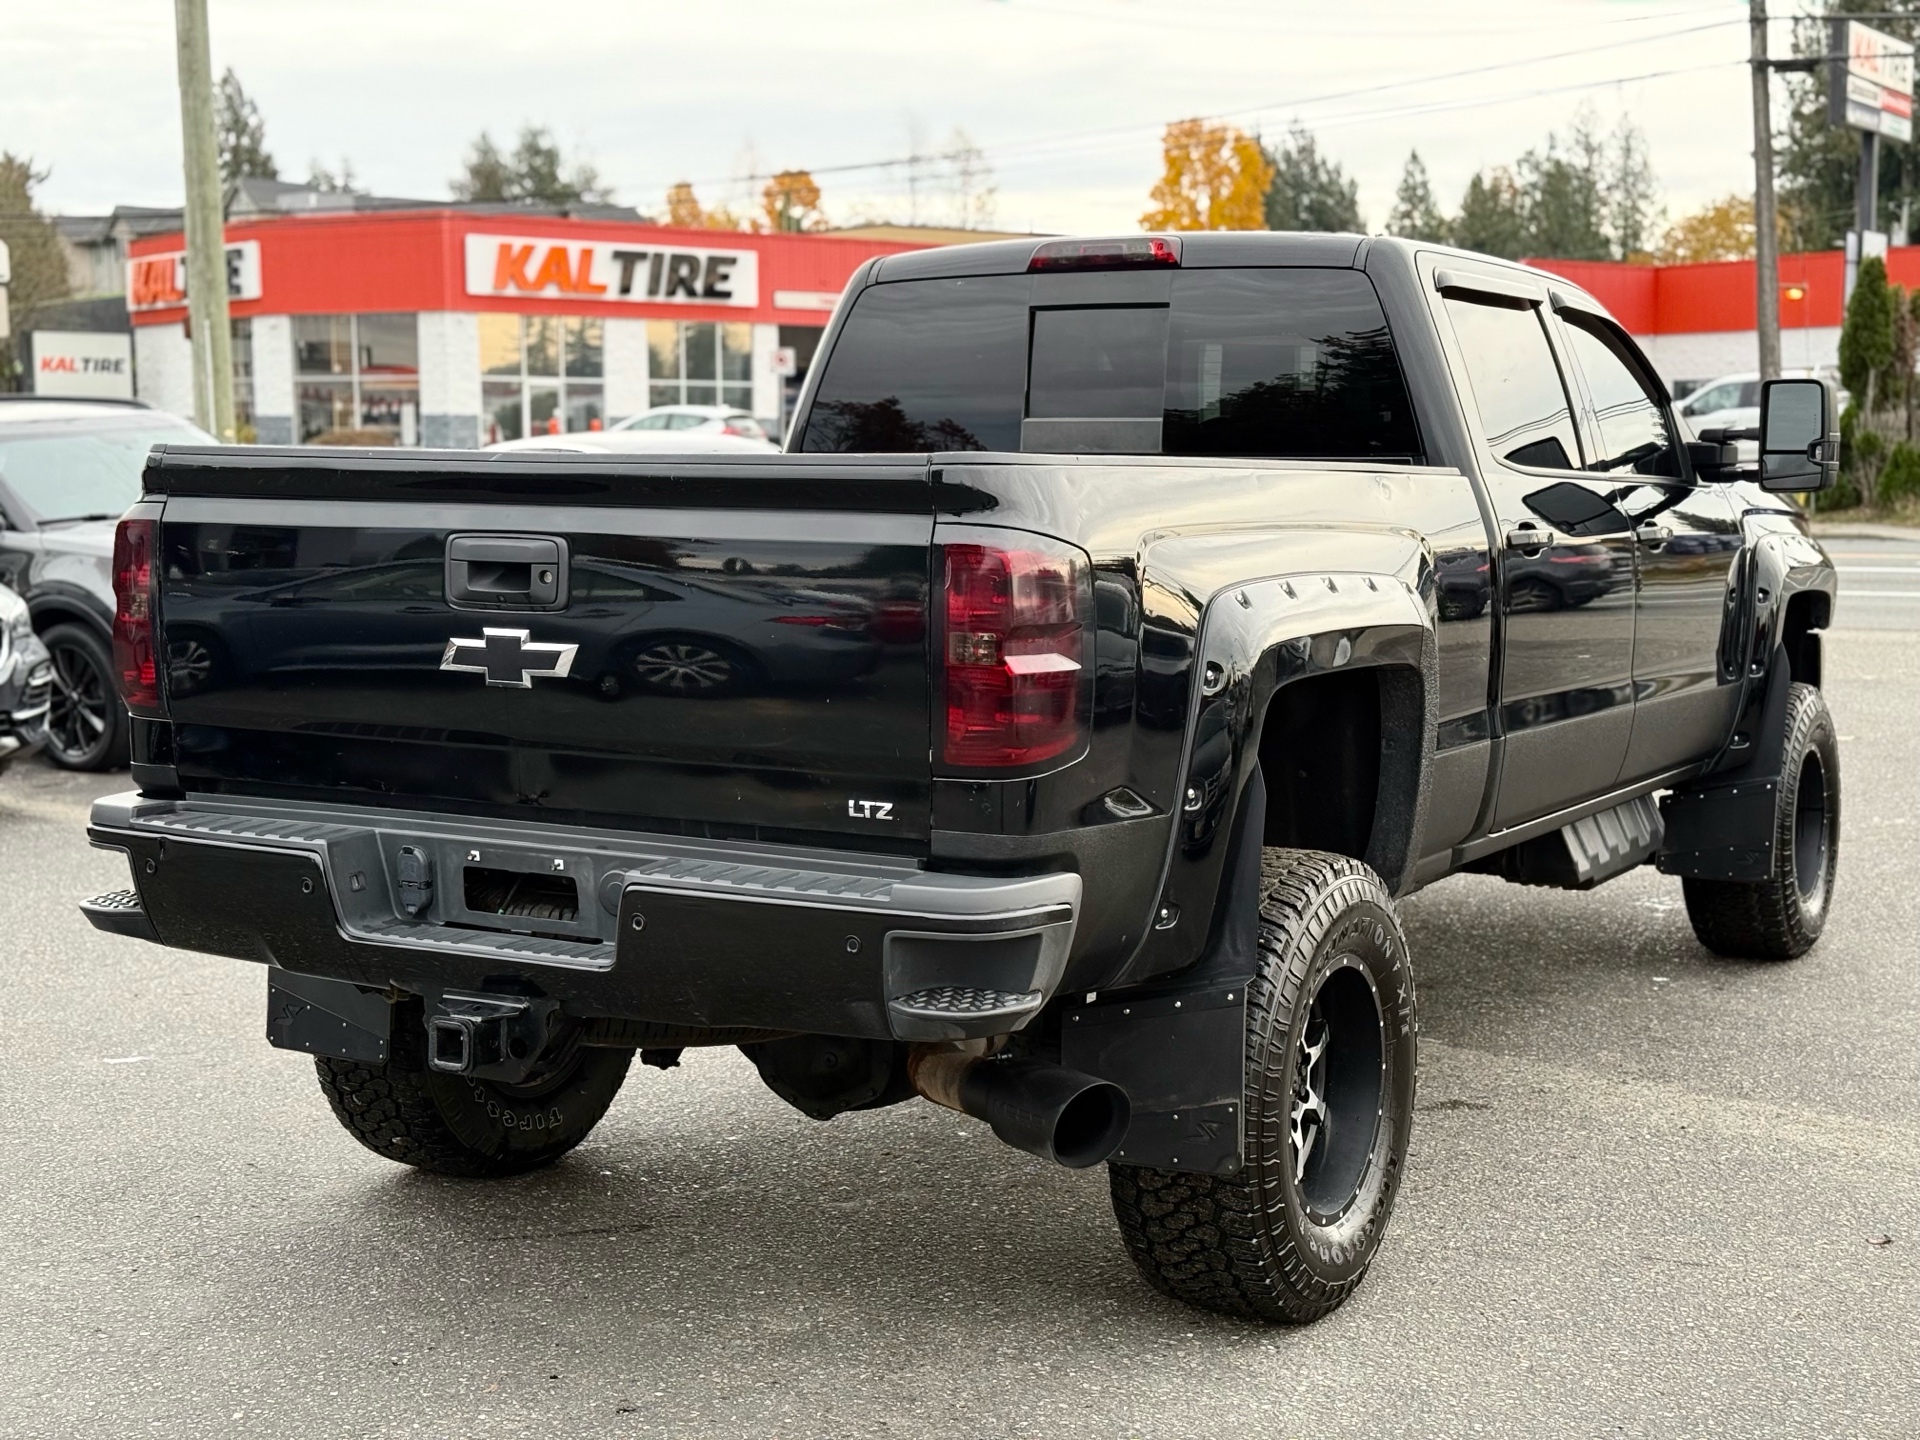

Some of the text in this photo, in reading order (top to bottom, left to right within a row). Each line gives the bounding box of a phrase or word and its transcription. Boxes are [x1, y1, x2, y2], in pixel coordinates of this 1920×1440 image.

[493, 243, 737, 299] KAL TIRE
[40, 355, 125, 374] KAL TIRE
[848, 799, 894, 821] LTZ
